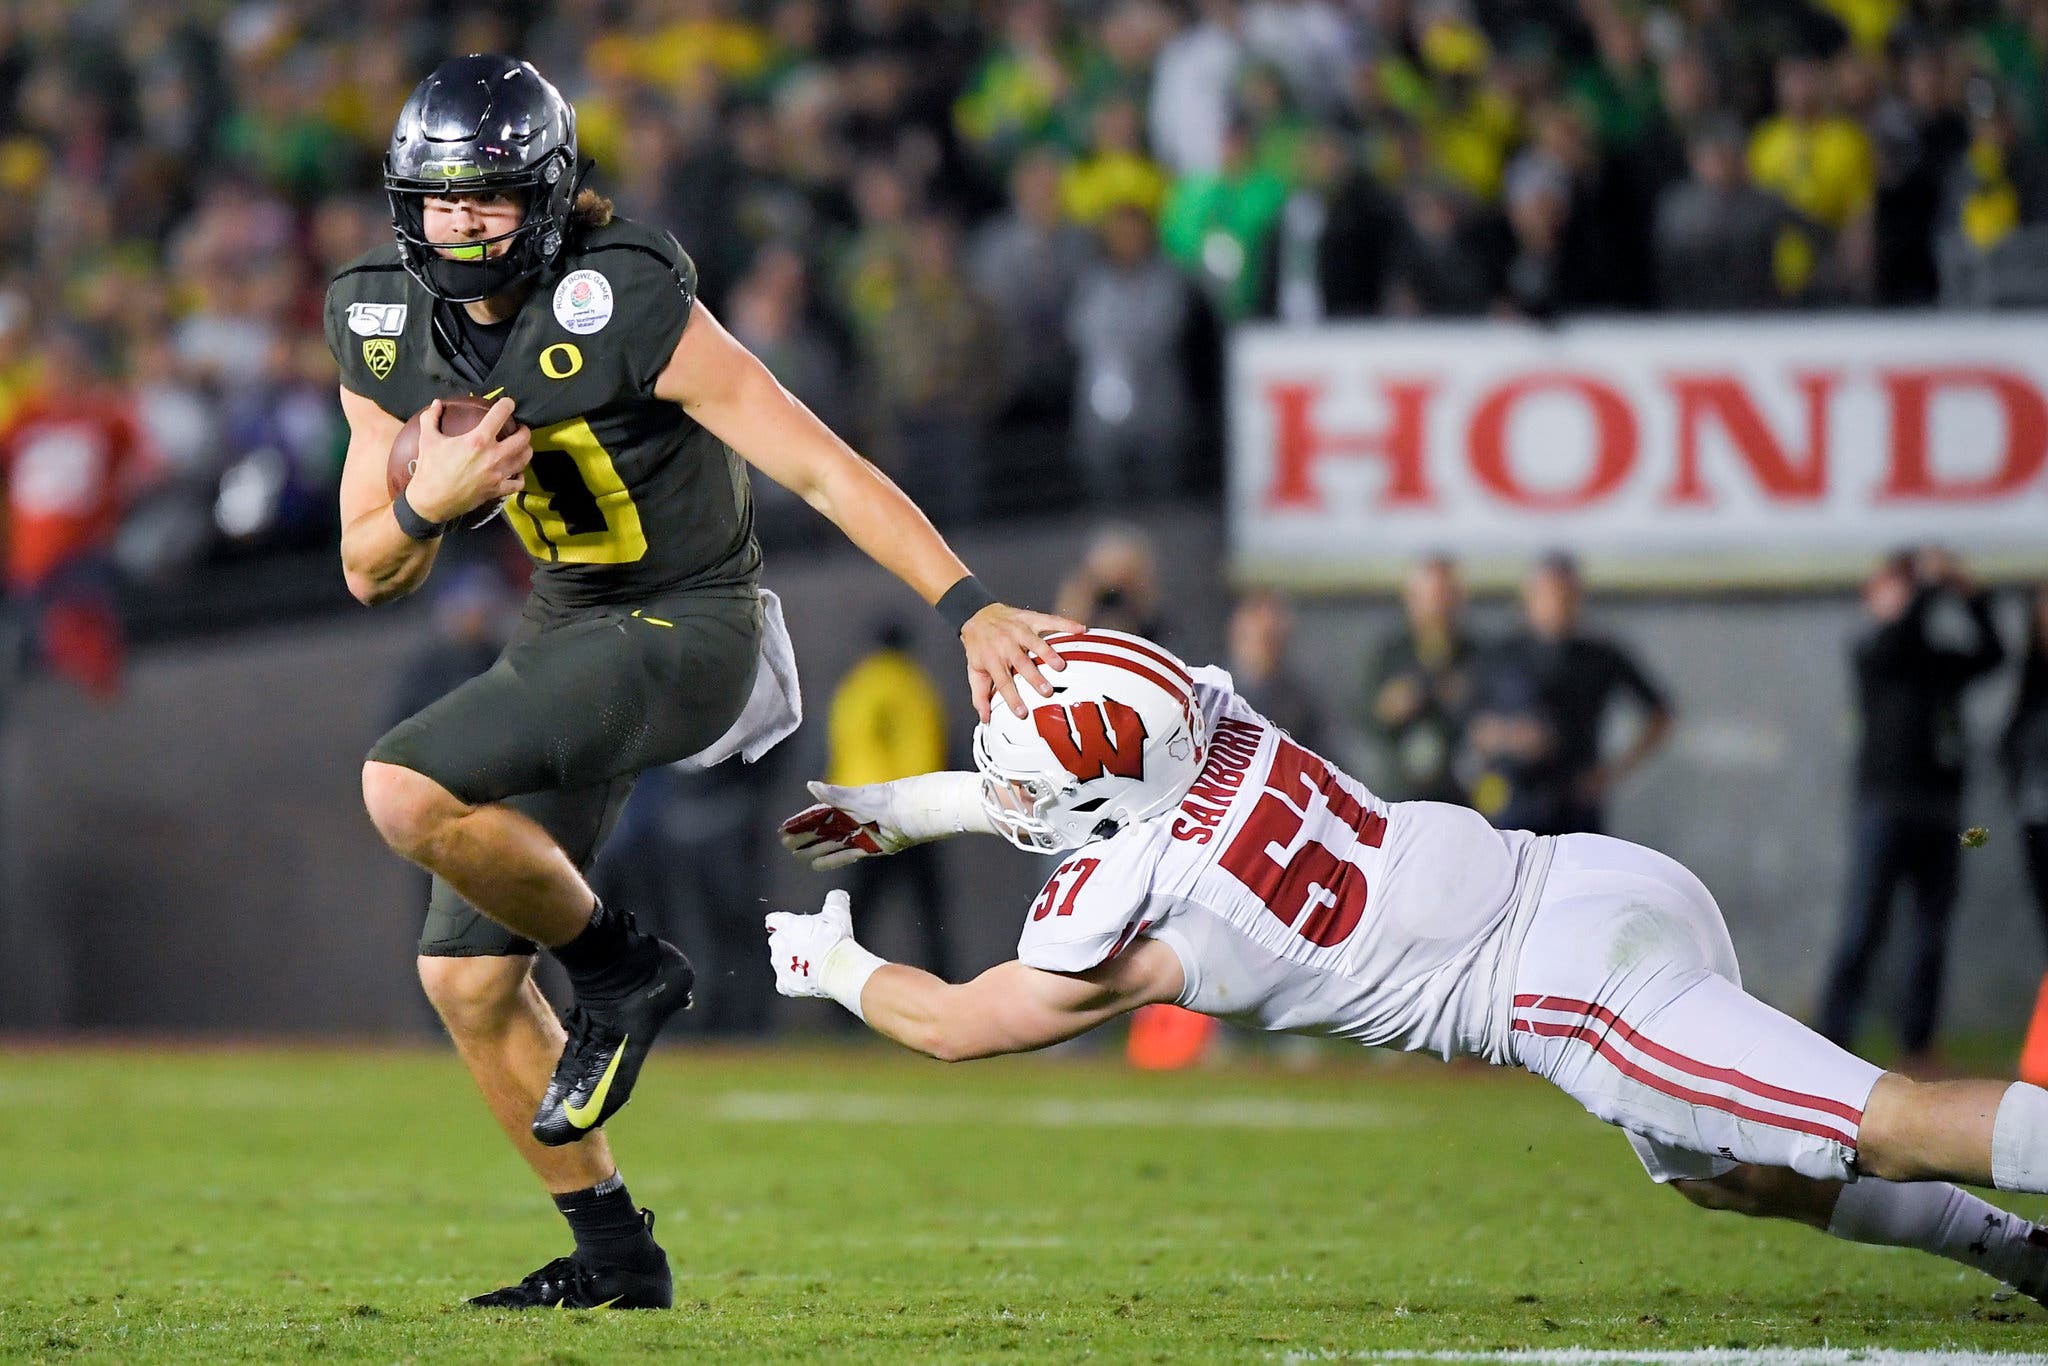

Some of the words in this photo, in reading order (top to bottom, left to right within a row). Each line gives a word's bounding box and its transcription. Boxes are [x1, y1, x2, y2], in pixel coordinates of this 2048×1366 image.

[556, 283, 568, 309] ROSE
[568, 272, 593, 284] BOWL
[593, 276, 609, 301] GAME
[364, 340, 395, 363] PAC
[372, 355, 389, 371] 12
[539, 343, 583, 379] O
[1263, 366, 2048, 512] HOND
[1033, 695, 1149, 785] W
[1171, 717, 1265, 844] SANBORN
[1218, 737, 1388, 948] 57
[1033, 858, 1101, 922] 57
